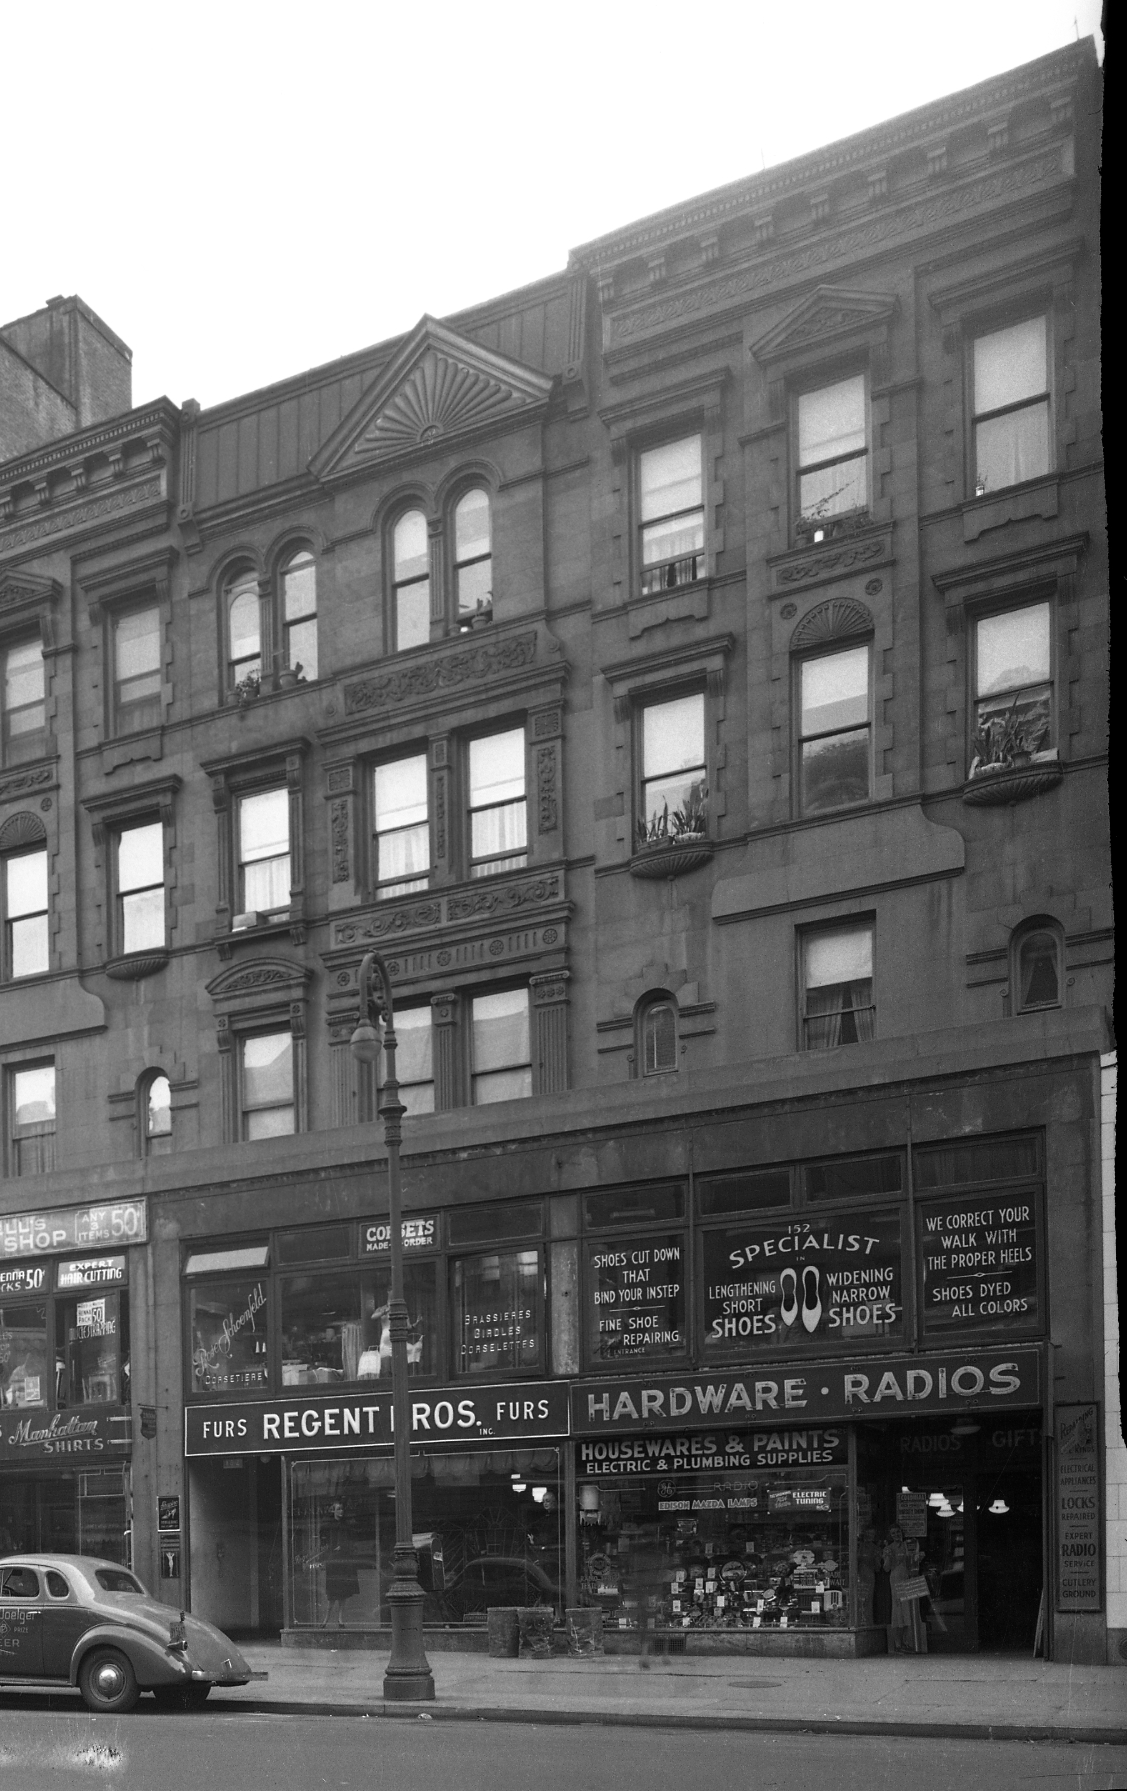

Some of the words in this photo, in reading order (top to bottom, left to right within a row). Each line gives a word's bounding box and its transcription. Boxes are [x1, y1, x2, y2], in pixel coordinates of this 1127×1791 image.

[82, 1211, 106, 1223] ANY
[926, 1216, 943, 1232] WE
[946, 1210, 994, 1229] CORRECT
[998, 1206, 1030, 1224] YOUR
[90, 1221, 99, 1230] 3
[788, 1223, 811, 1234] 152
[4, 1230, 66, 1251] SHOP
[78, 1229, 110, 1241] ITEMS
[941, 1232, 977, 1249] WALK
[985, 1228, 1017, 1245] WITH
[594, 1253, 627, 1268] SHOES
[631, 1250, 650, 1264] CUT
[654, 1247, 680, 1262] DOWN
[729, 1233, 880, 1269] SPECIALIST
[928, 1255, 947, 1271] THE
[951, 1251, 996, 1268] PROPER
[1000, 1246, 1032, 1264] HEELS
[70, 1260, 114, 1271] EXPERT
[60, 1272, 83, 1285] HAIR
[84, 1267, 122, 1283] CUTTING
[622, 1268, 651, 1284] THAT
[709, 1280, 776, 1300] LENGTHENING
[826, 1267, 894, 1287] WIDENING
[594, 1290, 616, 1305] BIND
[618, 1287, 643, 1302] YOUR
[646, 1284, 680, 1300] INSTEP
[933, 1285, 973, 1302] SHOES
[980, 1281, 1011, 1297] DYED
[723, 1298, 763, 1315] SHORT
[832, 1285, 891, 1304] NARROW
[951, 1303, 975, 1318] ALL
[979, 1298, 1028, 1315] COLORS
[464, 1310, 531, 1325] BRASSIERES
[599, 1318, 622, 1332] FINE
[629, 1315, 659, 1329] SHOE
[711, 1314, 776, 1339] SHOES
[828, 1303, 897, 1328] SHOES
[474, 1326, 521, 1339] GIRDLES
[623, 1330, 679, 1346] REPAIRING
[461, 1339, 535, 1355] CORSELETTES
[614, 1347, 645, 1355] ENTRANCE
[206, 1372, 262, 1385] CORSETIERE
[587, 1378, 809, 1422] HARDWARE
[843, 1362, 1022, 1405] RADIOS
[203, 1418, 248, 1439] FURS
[263, 1406, 380, 1440] REGENT
[391, 1400, 482, 1432] ROS.
[497, 1400, 549, 1421] FURS
[8, 1413, 97, 1446] Manhattan
[479, 1428, 496, 1436] INC.
[581, 1437, 717, 1461] HOUSEWARES
[725, 1435, 745, 1453] &
[753, 1429, 840, 1452] PAINTS
[900, 1434, 961, 1453] RADIOS
[586, 1459, 651, 1474] ELECTRIC
[656, 1459, 668, 1471] &
[673, 1454, 750, 1470] PLUMBING
[757, 1450, 833, 1465] SUPPLIES
[1060, 1464, 1095, 1474] ELECTRICAL
[713, 1480, 759, 1492] RADIO
[1060, 1476, 1096, 1485] APPLIANCES
[658, 1500, 691, 1511] EDISON
[691, 1499, 726, 1510] MAZDA
[727, 1498, 758, 1509] LAMPS
[1062, 1496, 1096, 1510] LOCKS
[1065, 1532, 1093, 1540] EXPERT
[1062, 1543, 1096, 1557] RADIO
[1064, 1560, 1095, 1568] SERVICE
[1062, 1578, 1096, 1587] CUTLERY
[1062, 1590, 1096, 1599] GROUND
[0, 1607, 35, 1624] Doelger
